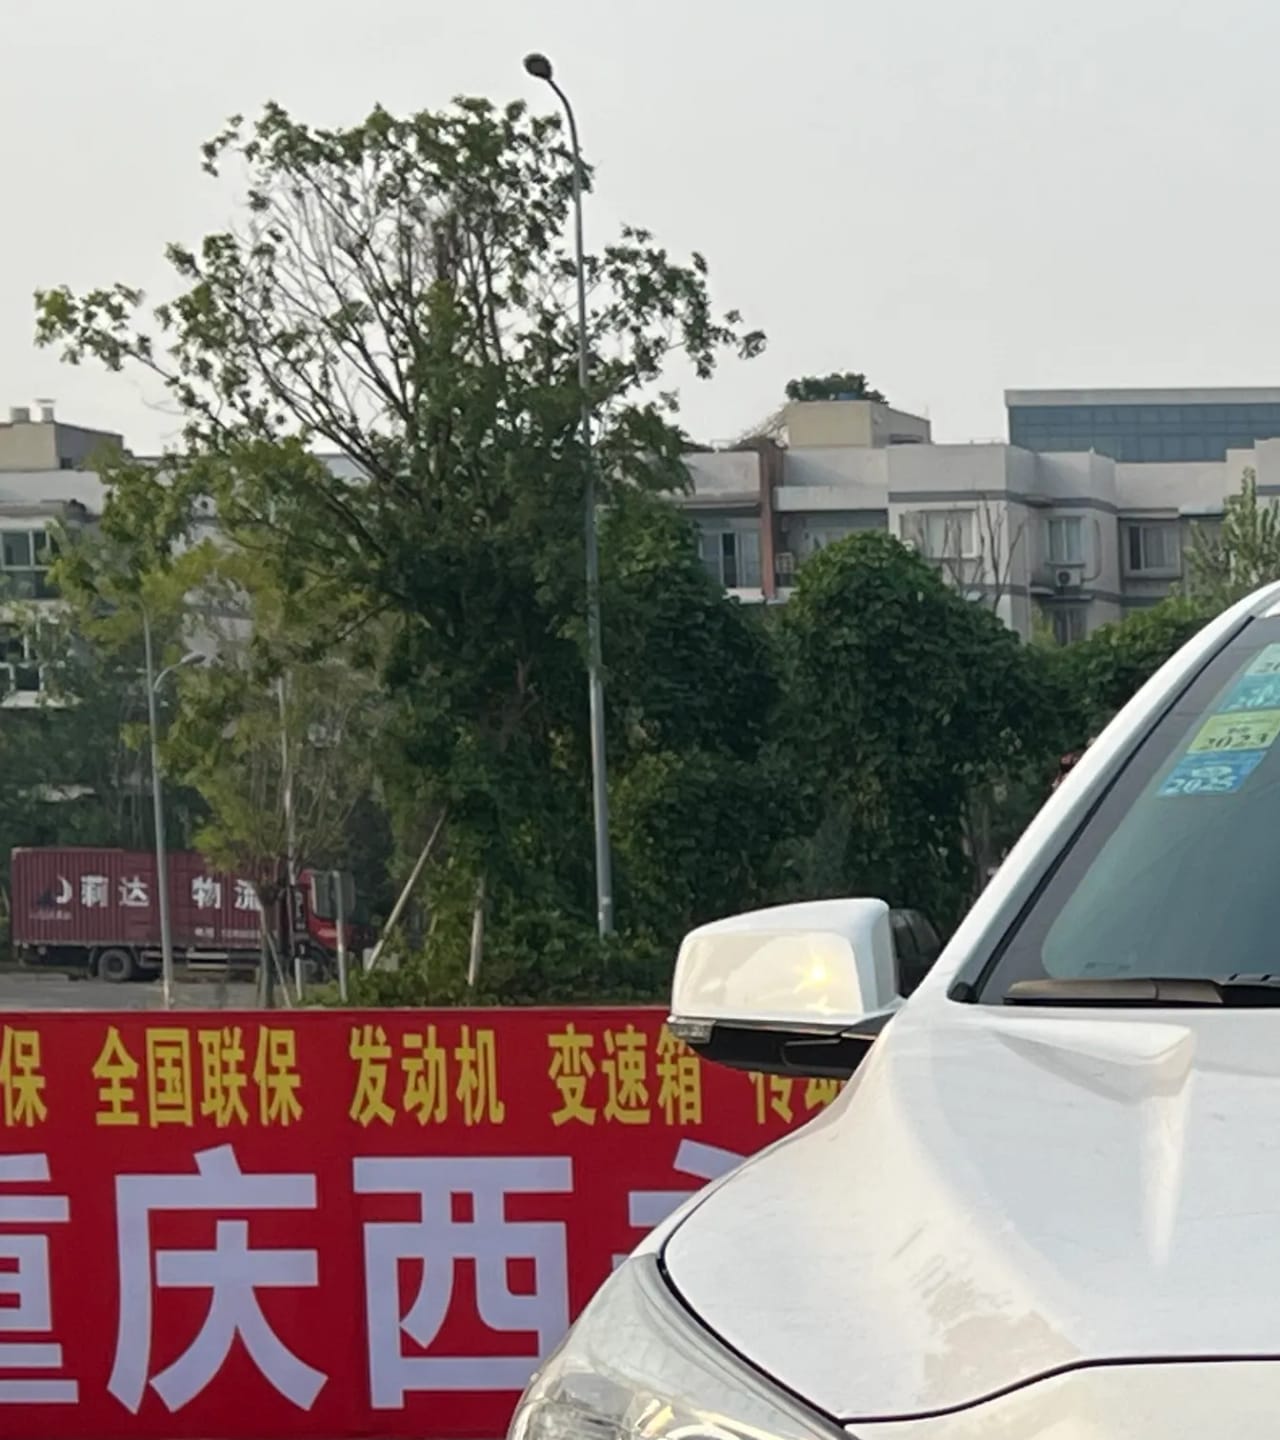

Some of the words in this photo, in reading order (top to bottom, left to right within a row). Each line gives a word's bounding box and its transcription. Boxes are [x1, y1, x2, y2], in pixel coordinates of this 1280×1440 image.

[92, 1024, 303, 1128] 全国联保
[349, 1023, 505, 1127] 发动机
[548, 1022, 703, 1126] 变速箱
